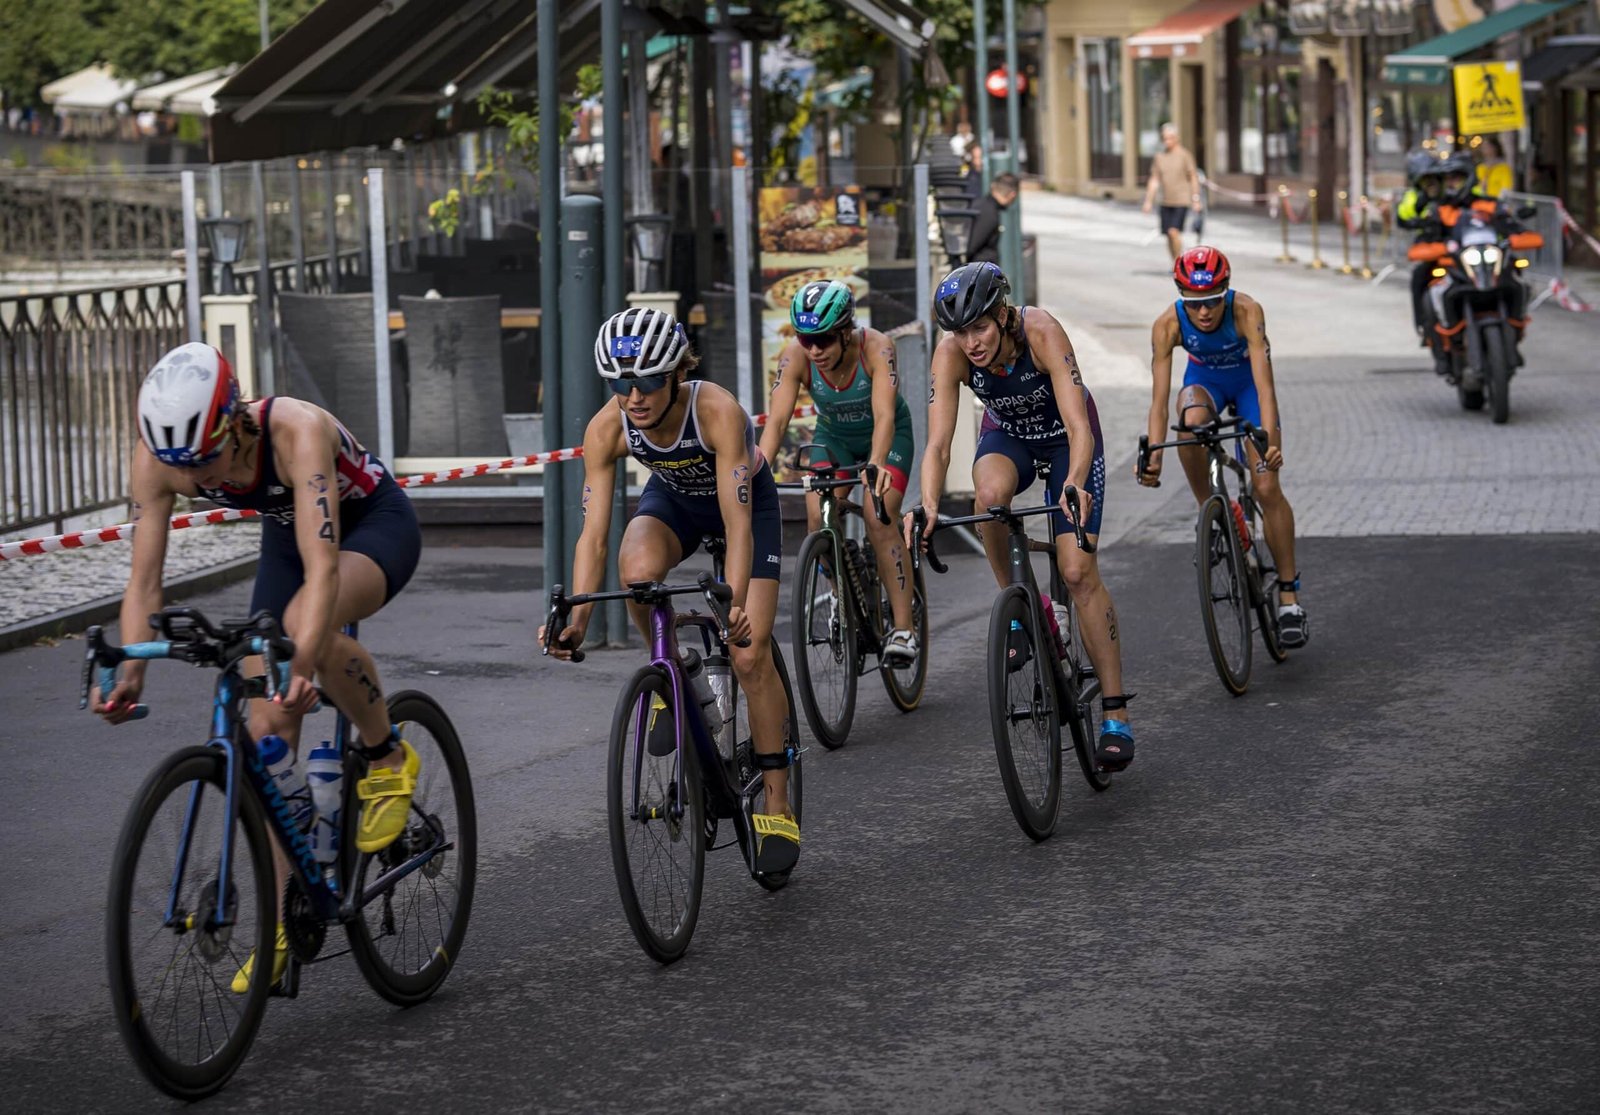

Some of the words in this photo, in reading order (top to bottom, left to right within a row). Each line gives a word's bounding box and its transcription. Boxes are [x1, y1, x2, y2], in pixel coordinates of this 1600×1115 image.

[799, 315, 807, 323] 17
[616, 340, 623, 350] 6
[771, 368, 783, 391] 17
[887, 359, 897, 386] 17
[1070, 369, 1083, 386] 2
[981, 384, 1051, 411] RAPPAPORT
[836, 410, 871, 423] MEX
[736, 484, 749, 504] 6
[316, 497, 336, 544] 14
[895, 560, 906, 591] 17
[1109, 624, 1117, 641] 2
